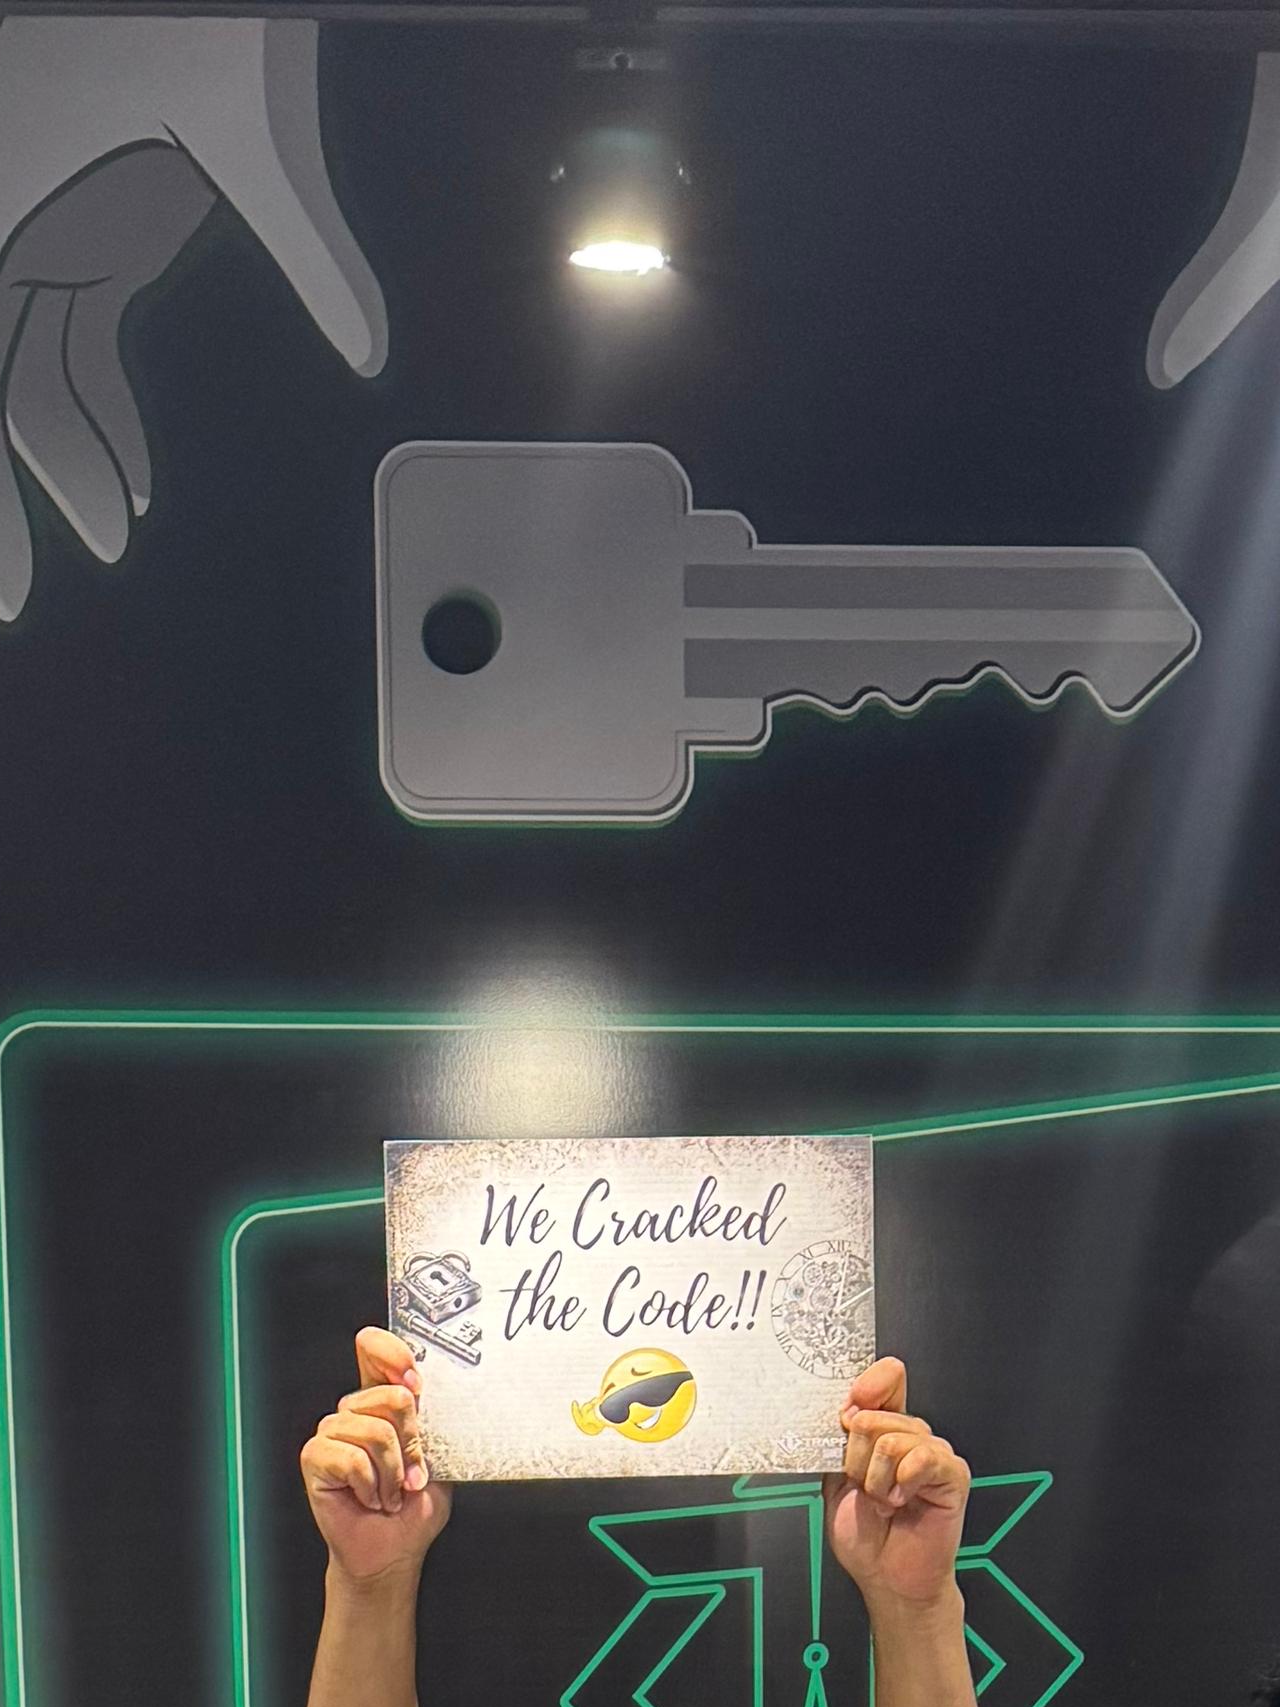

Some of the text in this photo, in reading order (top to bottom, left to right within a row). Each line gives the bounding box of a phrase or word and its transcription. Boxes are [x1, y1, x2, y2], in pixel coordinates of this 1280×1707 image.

[480, 1176, 787, 1250] We Cracked
[499, 1250, 767, 1341] the Code!!
